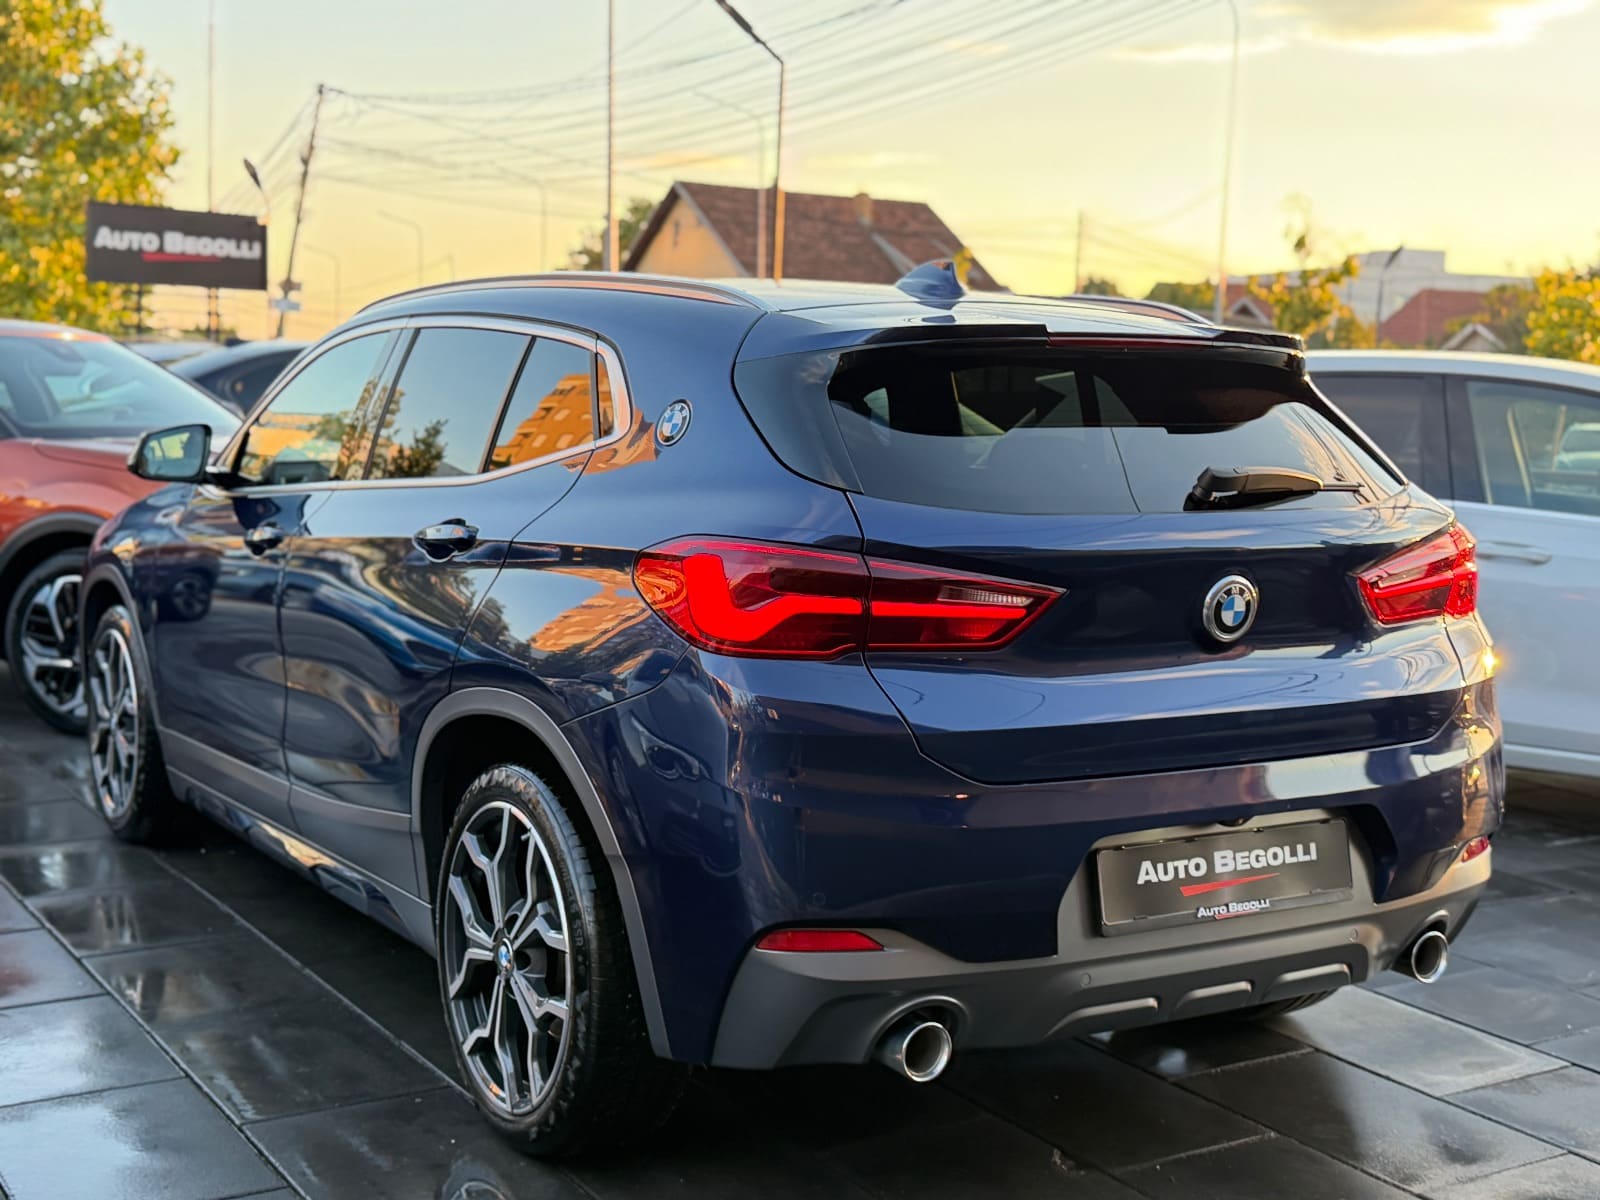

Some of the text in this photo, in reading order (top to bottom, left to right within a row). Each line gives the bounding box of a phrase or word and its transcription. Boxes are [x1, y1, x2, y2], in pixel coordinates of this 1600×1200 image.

[94, 225, 262, 260] AUTO BEGOLLI
[1219, 585, 1252, 603] BMW
[1137, 842, 1317, 885] AUTO BEGOLLI
[1197, 898, 1271, 918] AUTO BEGOLLI
